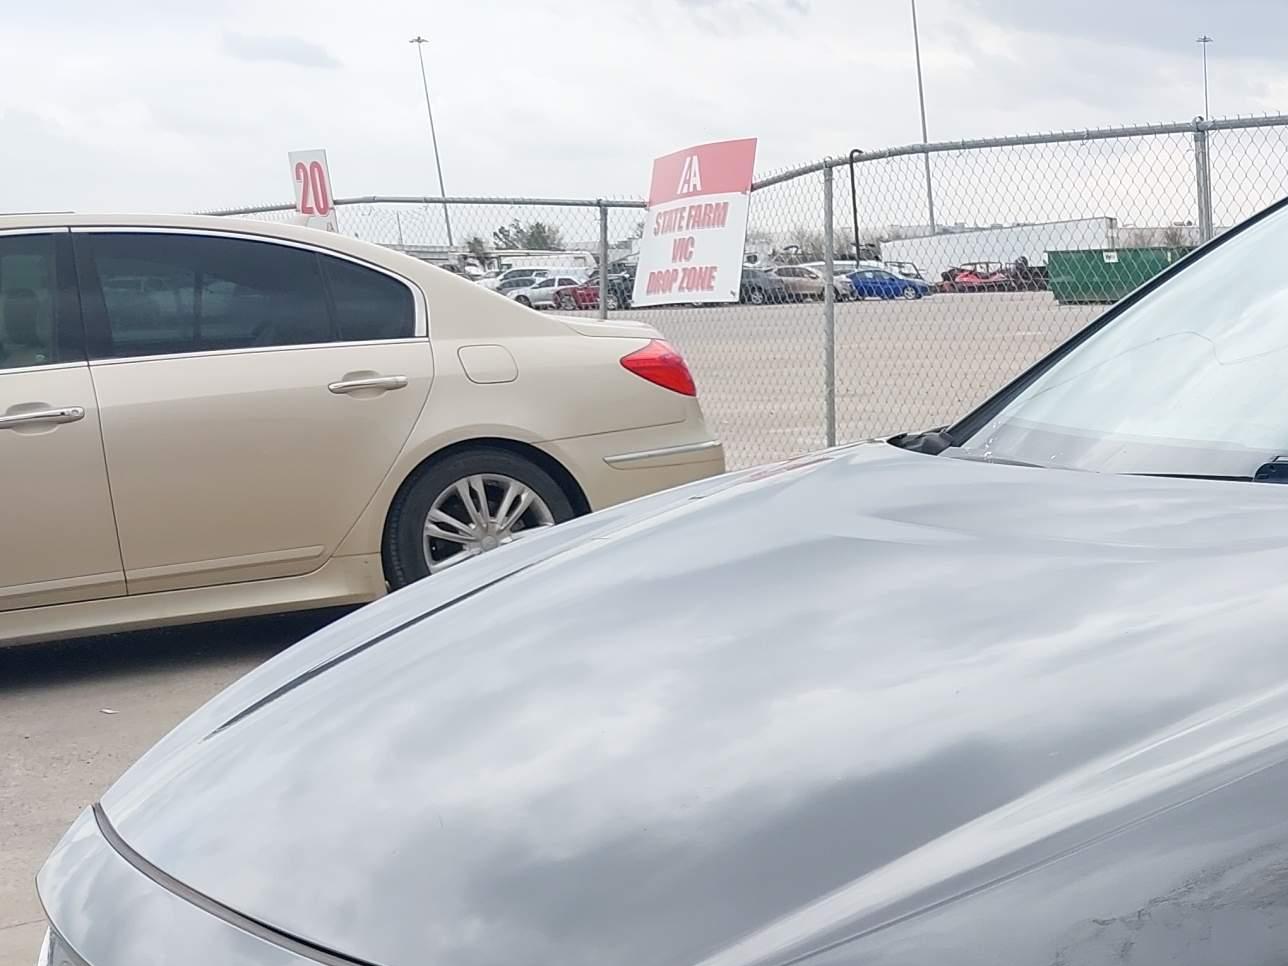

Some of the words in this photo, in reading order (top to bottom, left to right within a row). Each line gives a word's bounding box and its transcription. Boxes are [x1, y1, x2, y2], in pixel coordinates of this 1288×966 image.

[295, 161, 329, 215] 20
[653, 207, 686, 236] STATE
[685, 202, 729, 230] FARM
[672, 237, 695, 263] VIC
[646, 269, 679, 295] DROP
[678, 266, 717, 293] ZONE
